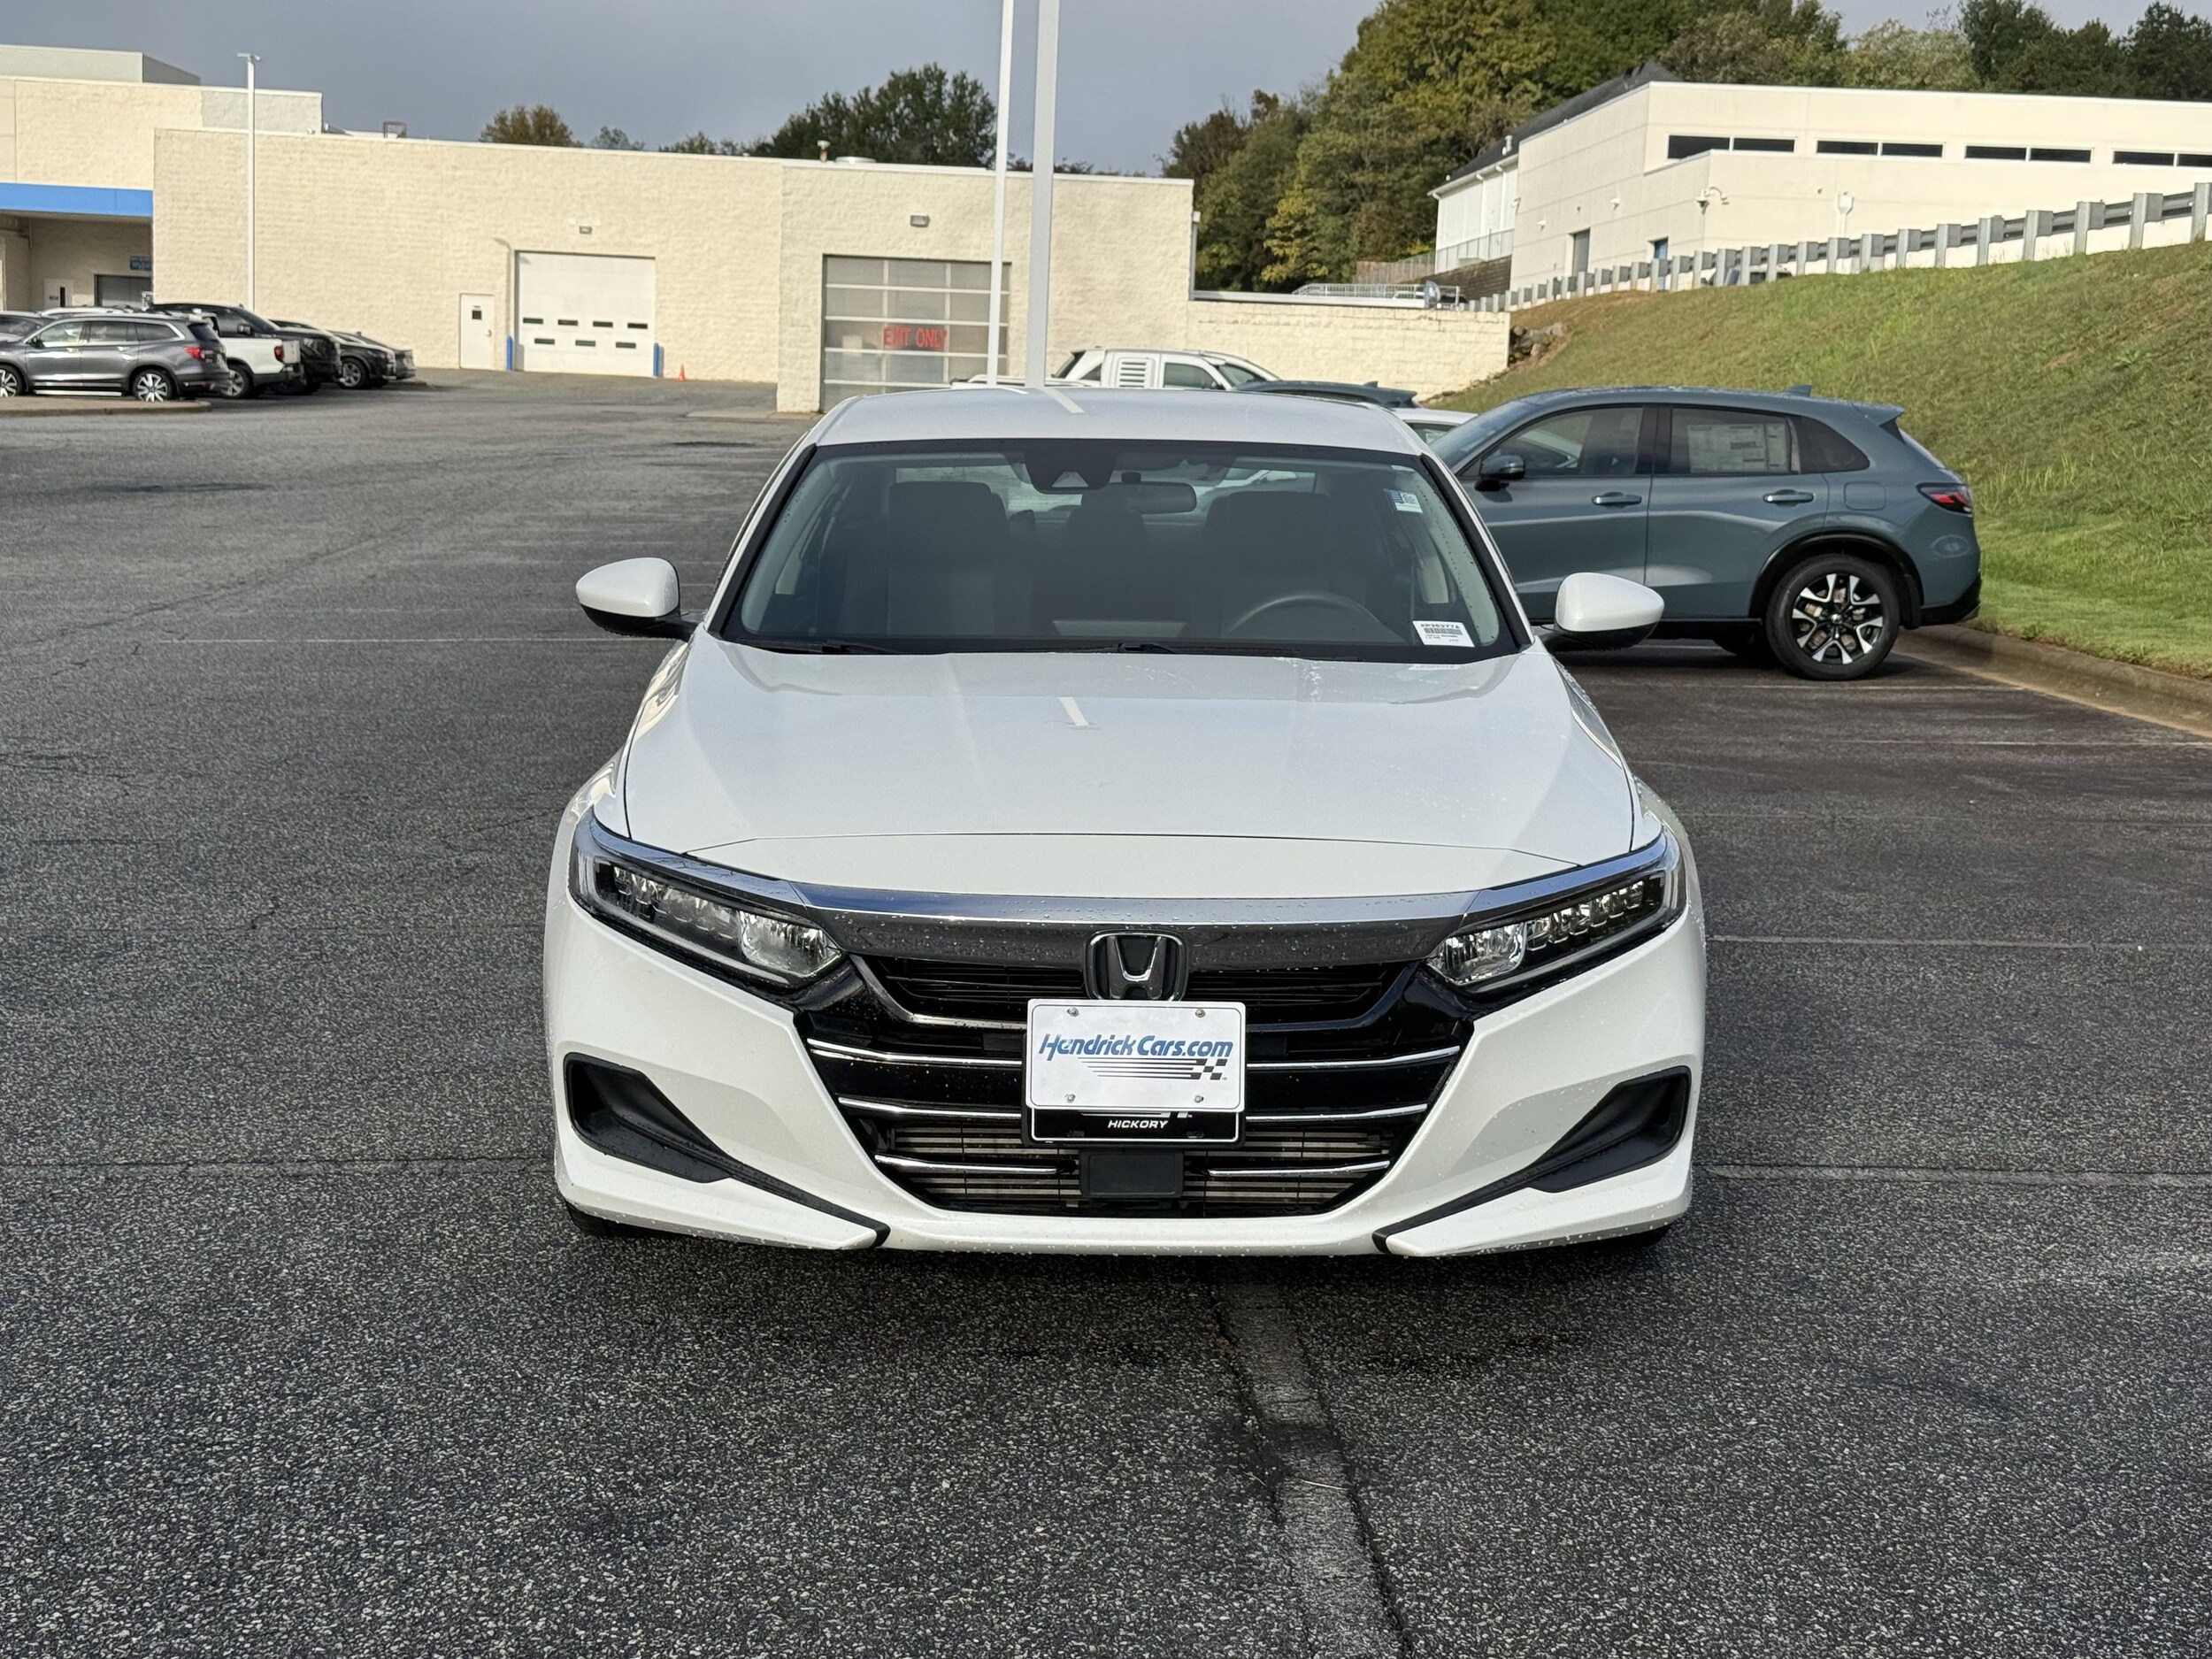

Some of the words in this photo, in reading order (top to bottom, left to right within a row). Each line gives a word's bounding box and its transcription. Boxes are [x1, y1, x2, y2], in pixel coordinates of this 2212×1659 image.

[884, 326, 910, 346] EXIT
[915, 327, 947, 348] ONLY
[1108, 1120, 1168, 1129] HICKORY
